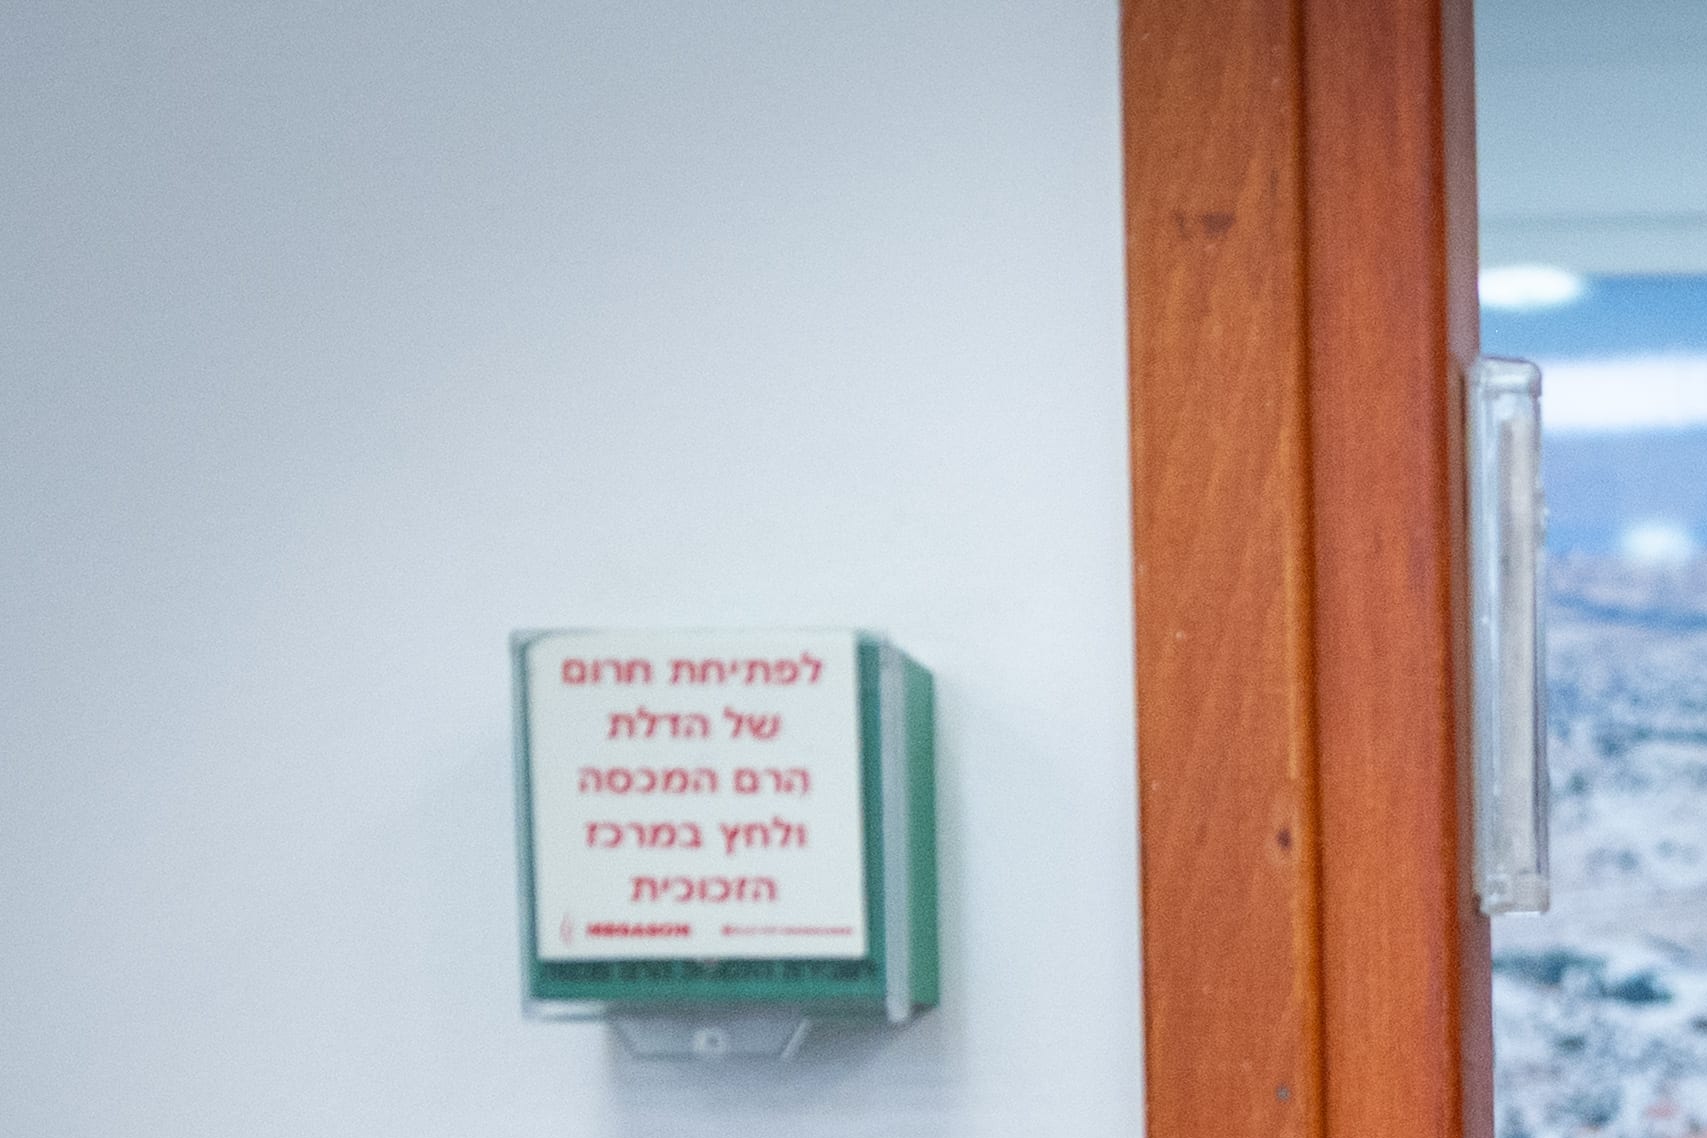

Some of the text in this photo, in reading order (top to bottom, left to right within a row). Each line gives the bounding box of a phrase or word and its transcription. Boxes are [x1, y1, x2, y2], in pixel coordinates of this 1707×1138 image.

[561, 652, 824, 686] לפתיחת חרום
[608, 706, 782, 741] של הדלת
[578, 766, 812, 796] הרם המכסה
[585, 816, 808, 855] ולחץ במרכז
[631, 875, 778, 904] הזכוכית
